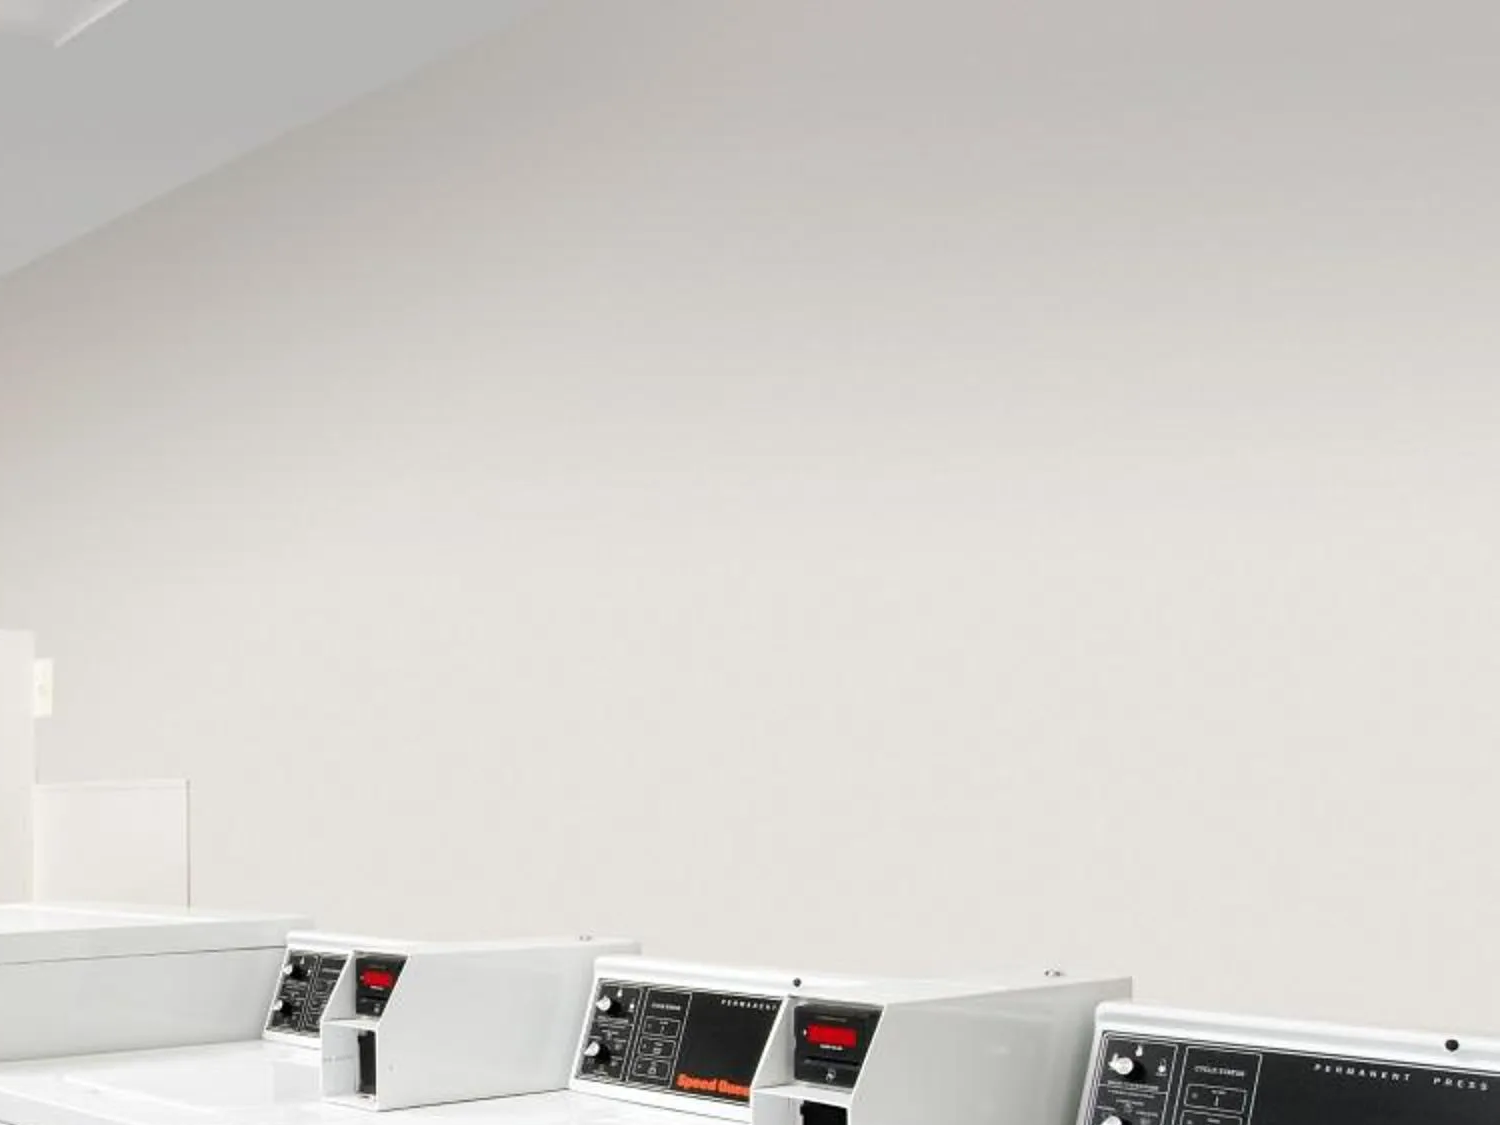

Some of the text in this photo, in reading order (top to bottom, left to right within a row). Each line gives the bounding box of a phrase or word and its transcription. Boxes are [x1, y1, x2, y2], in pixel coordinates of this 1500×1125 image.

[676, 1073, 717, 1092] Speed
[1313, 1062, 1489, 1092] PERMANENT PRESS
